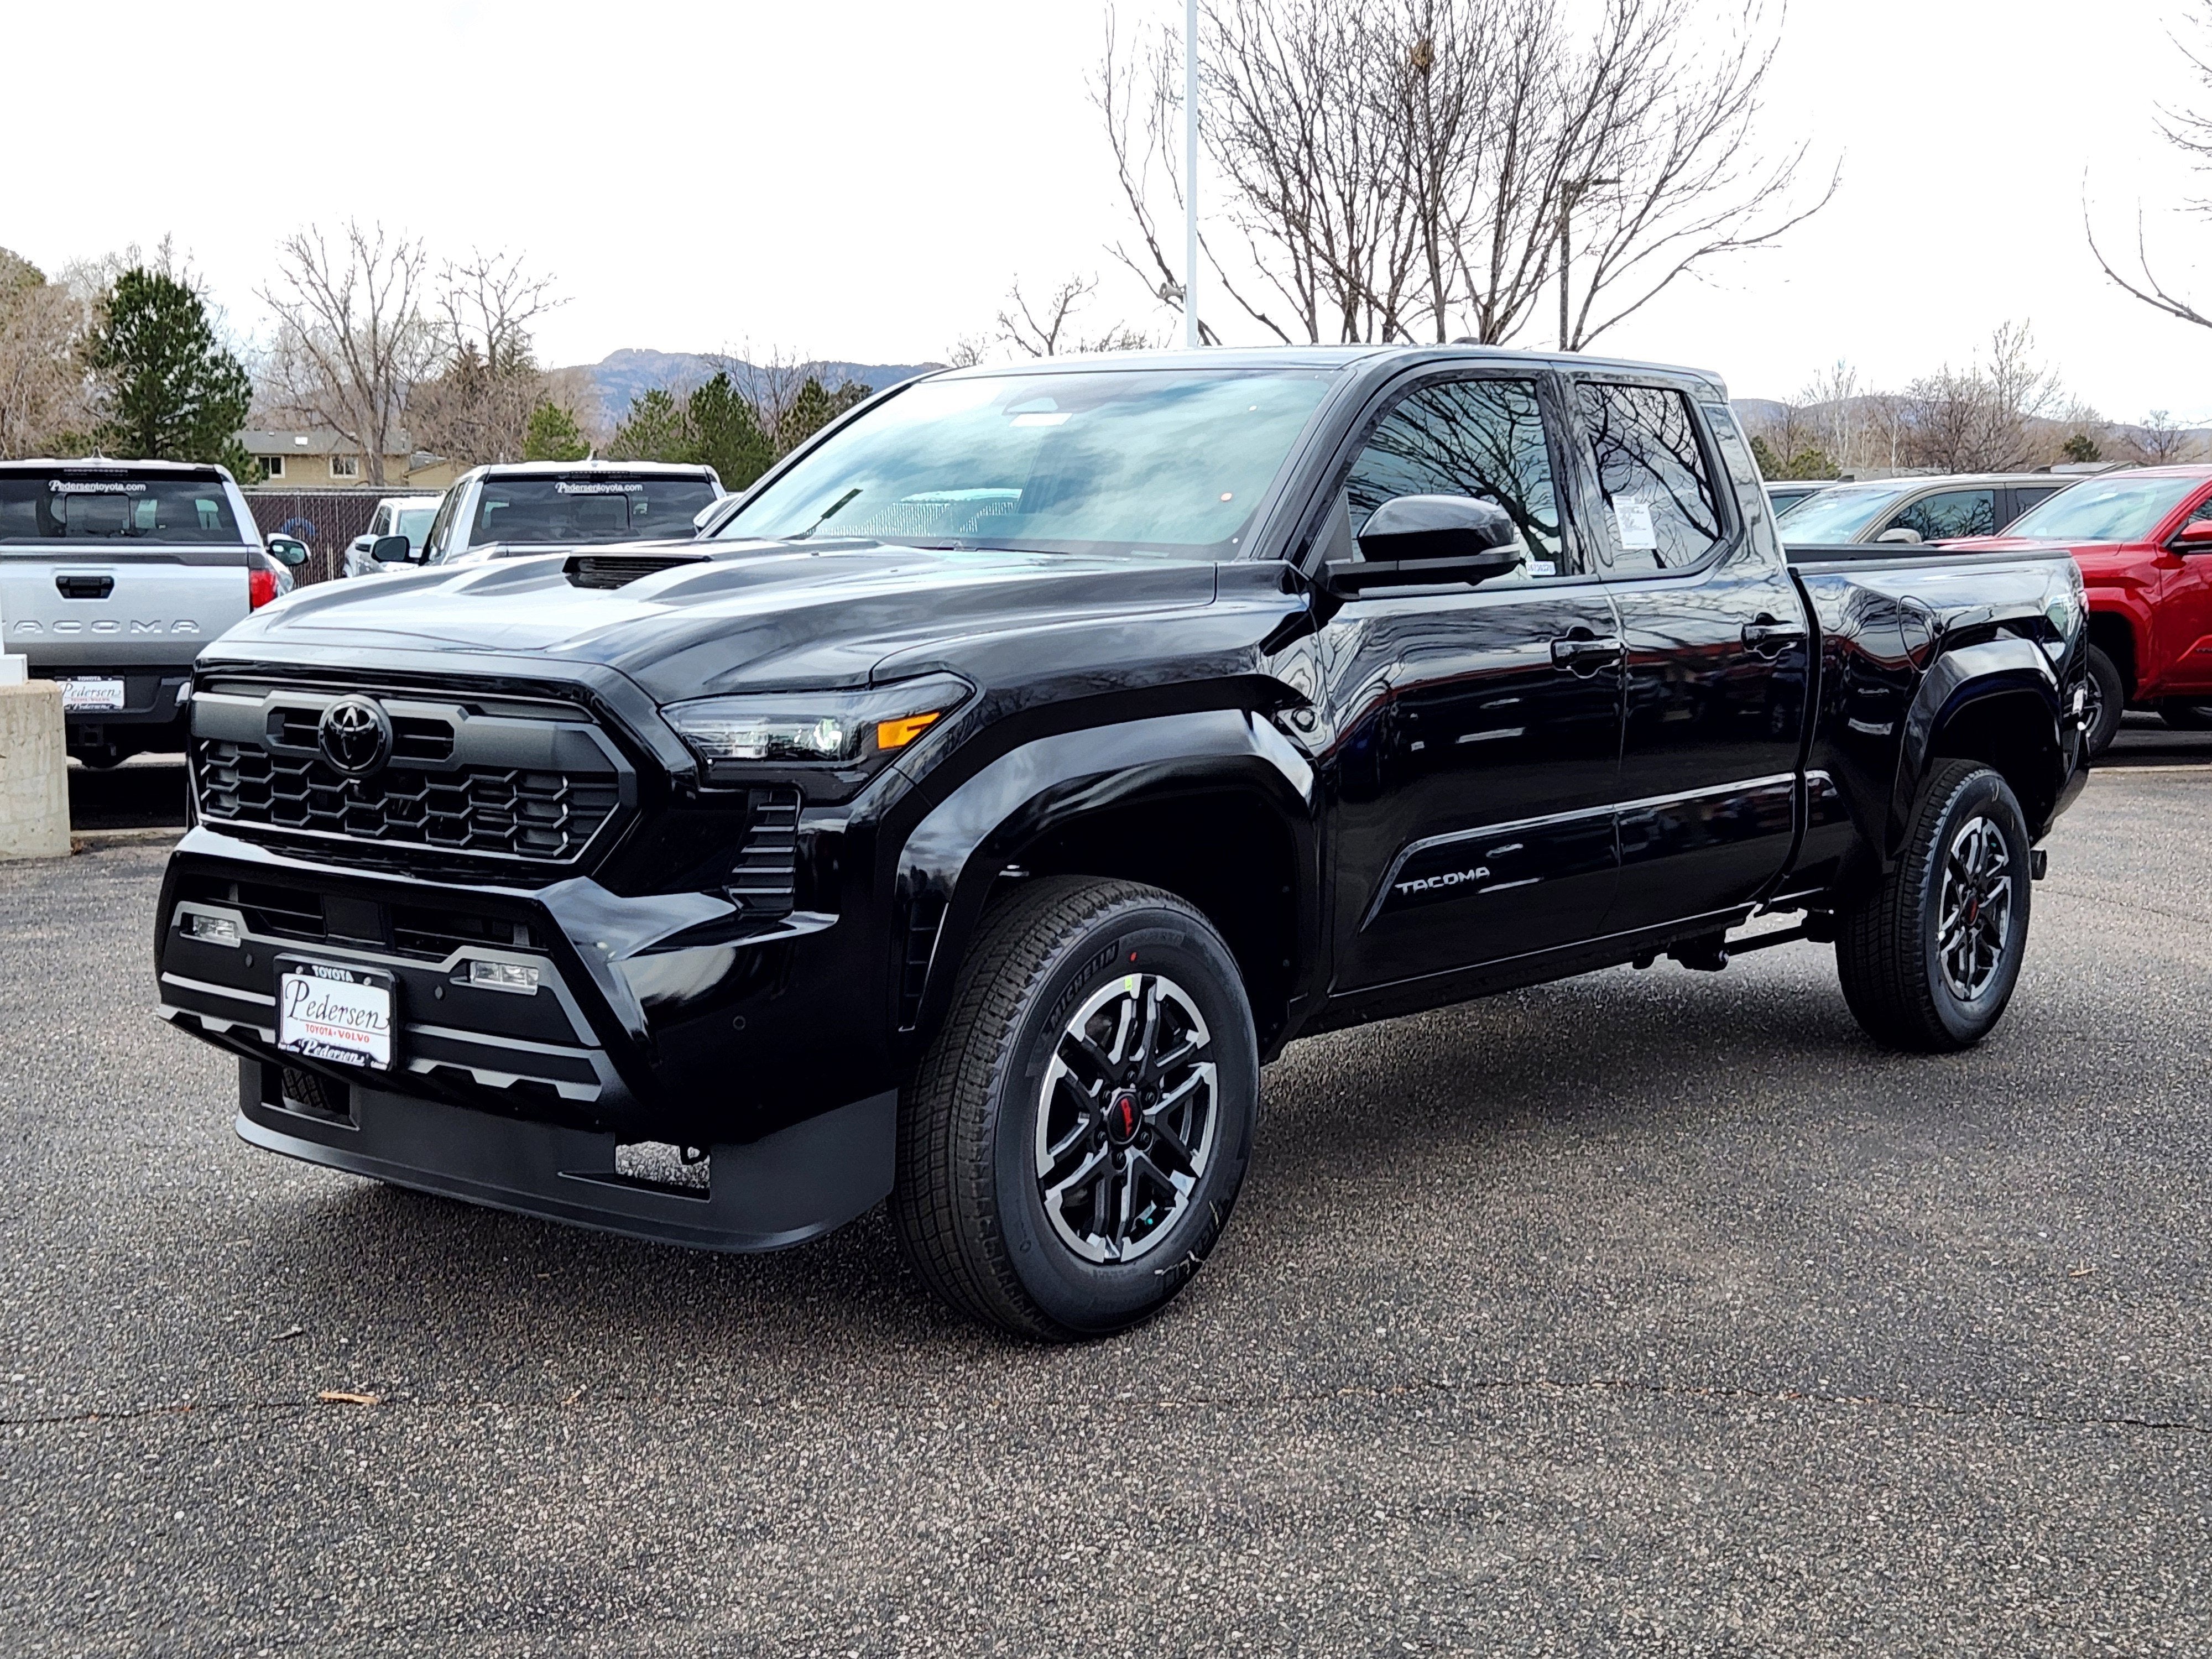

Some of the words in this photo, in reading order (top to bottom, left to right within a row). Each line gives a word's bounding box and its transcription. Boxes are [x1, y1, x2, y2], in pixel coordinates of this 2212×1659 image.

[2, 619, 200, 634] ACOMA
[1395, 867, 1490, 895] TACOMA
[311, 966, 354, 982] TOYOTA
[1051, 944, 1116, 1029] MICHELIN
[285, 979, 388, 1030] Pedersen
[306, 1024, 332, 1036] TOYOTA
[338, 1030, 370, 1044] VOLVO
[301, 1039, 365, 1067] Pedersen
